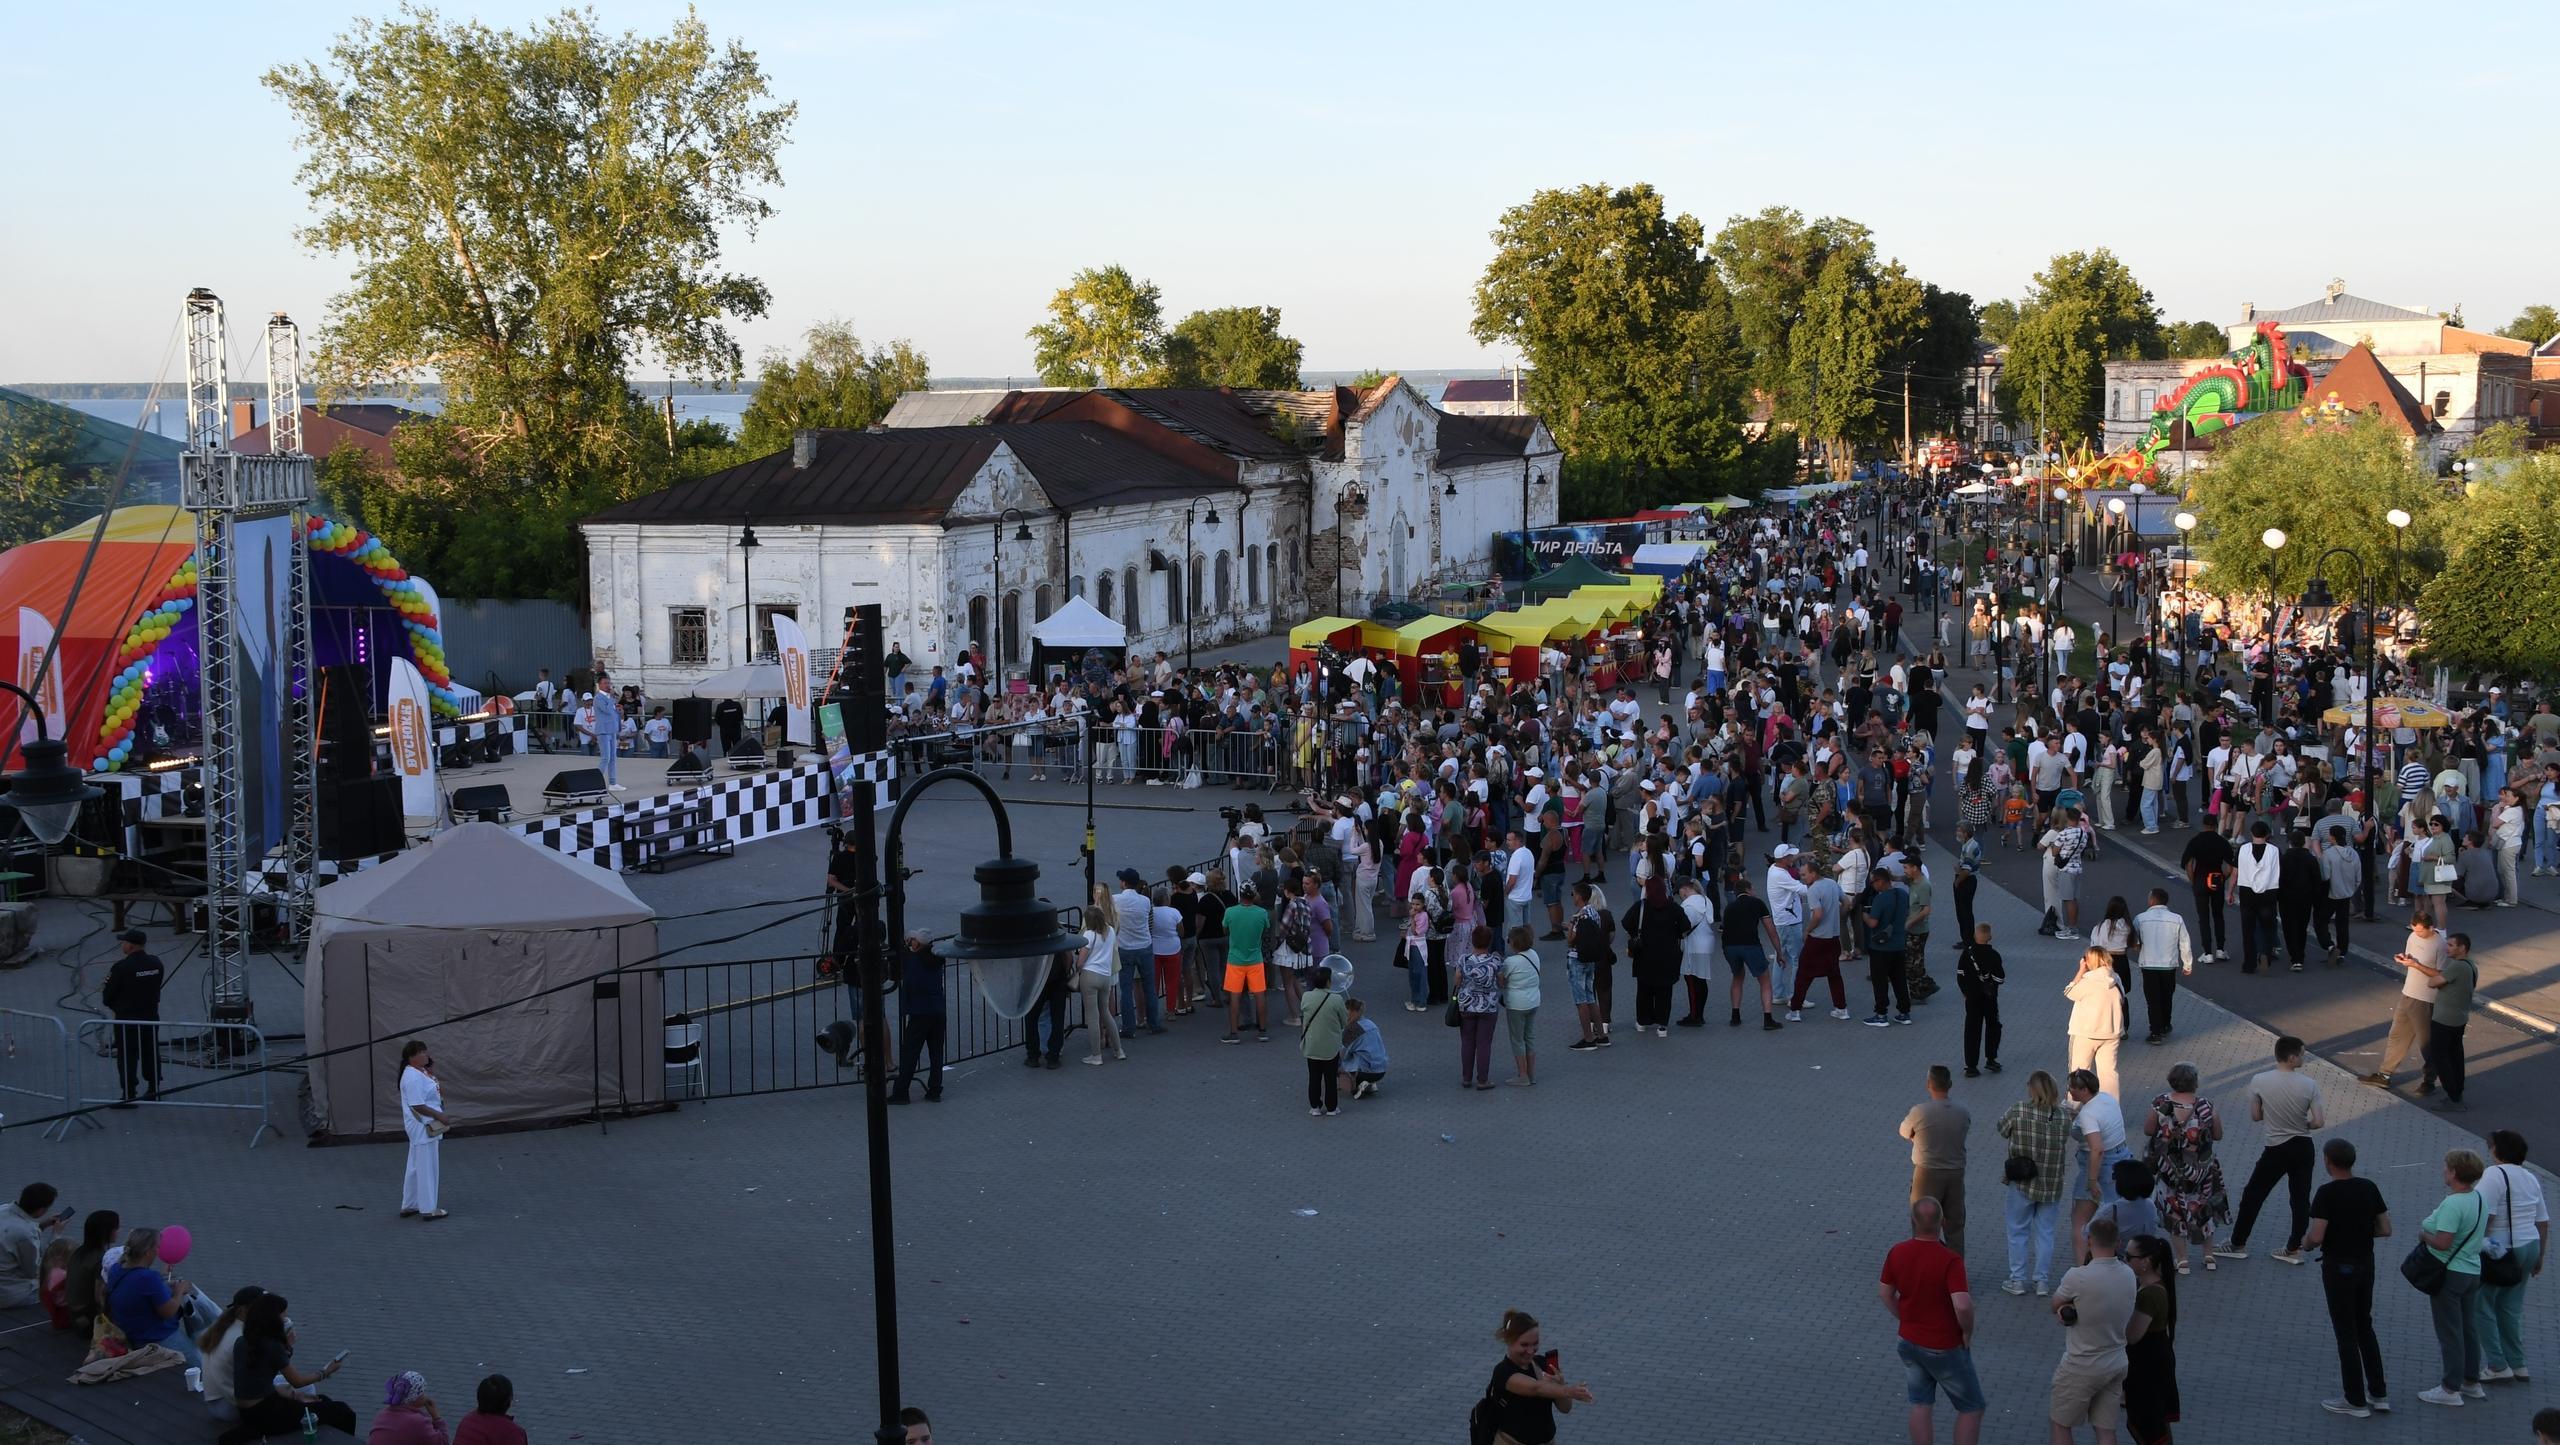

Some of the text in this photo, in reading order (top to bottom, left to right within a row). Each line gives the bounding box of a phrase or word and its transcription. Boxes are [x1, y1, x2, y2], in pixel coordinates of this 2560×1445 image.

[1531, 541, 1623, 556] ТИР ДЕЛЬТА
[400, 704, 418, 769] ВАСЮКИ
